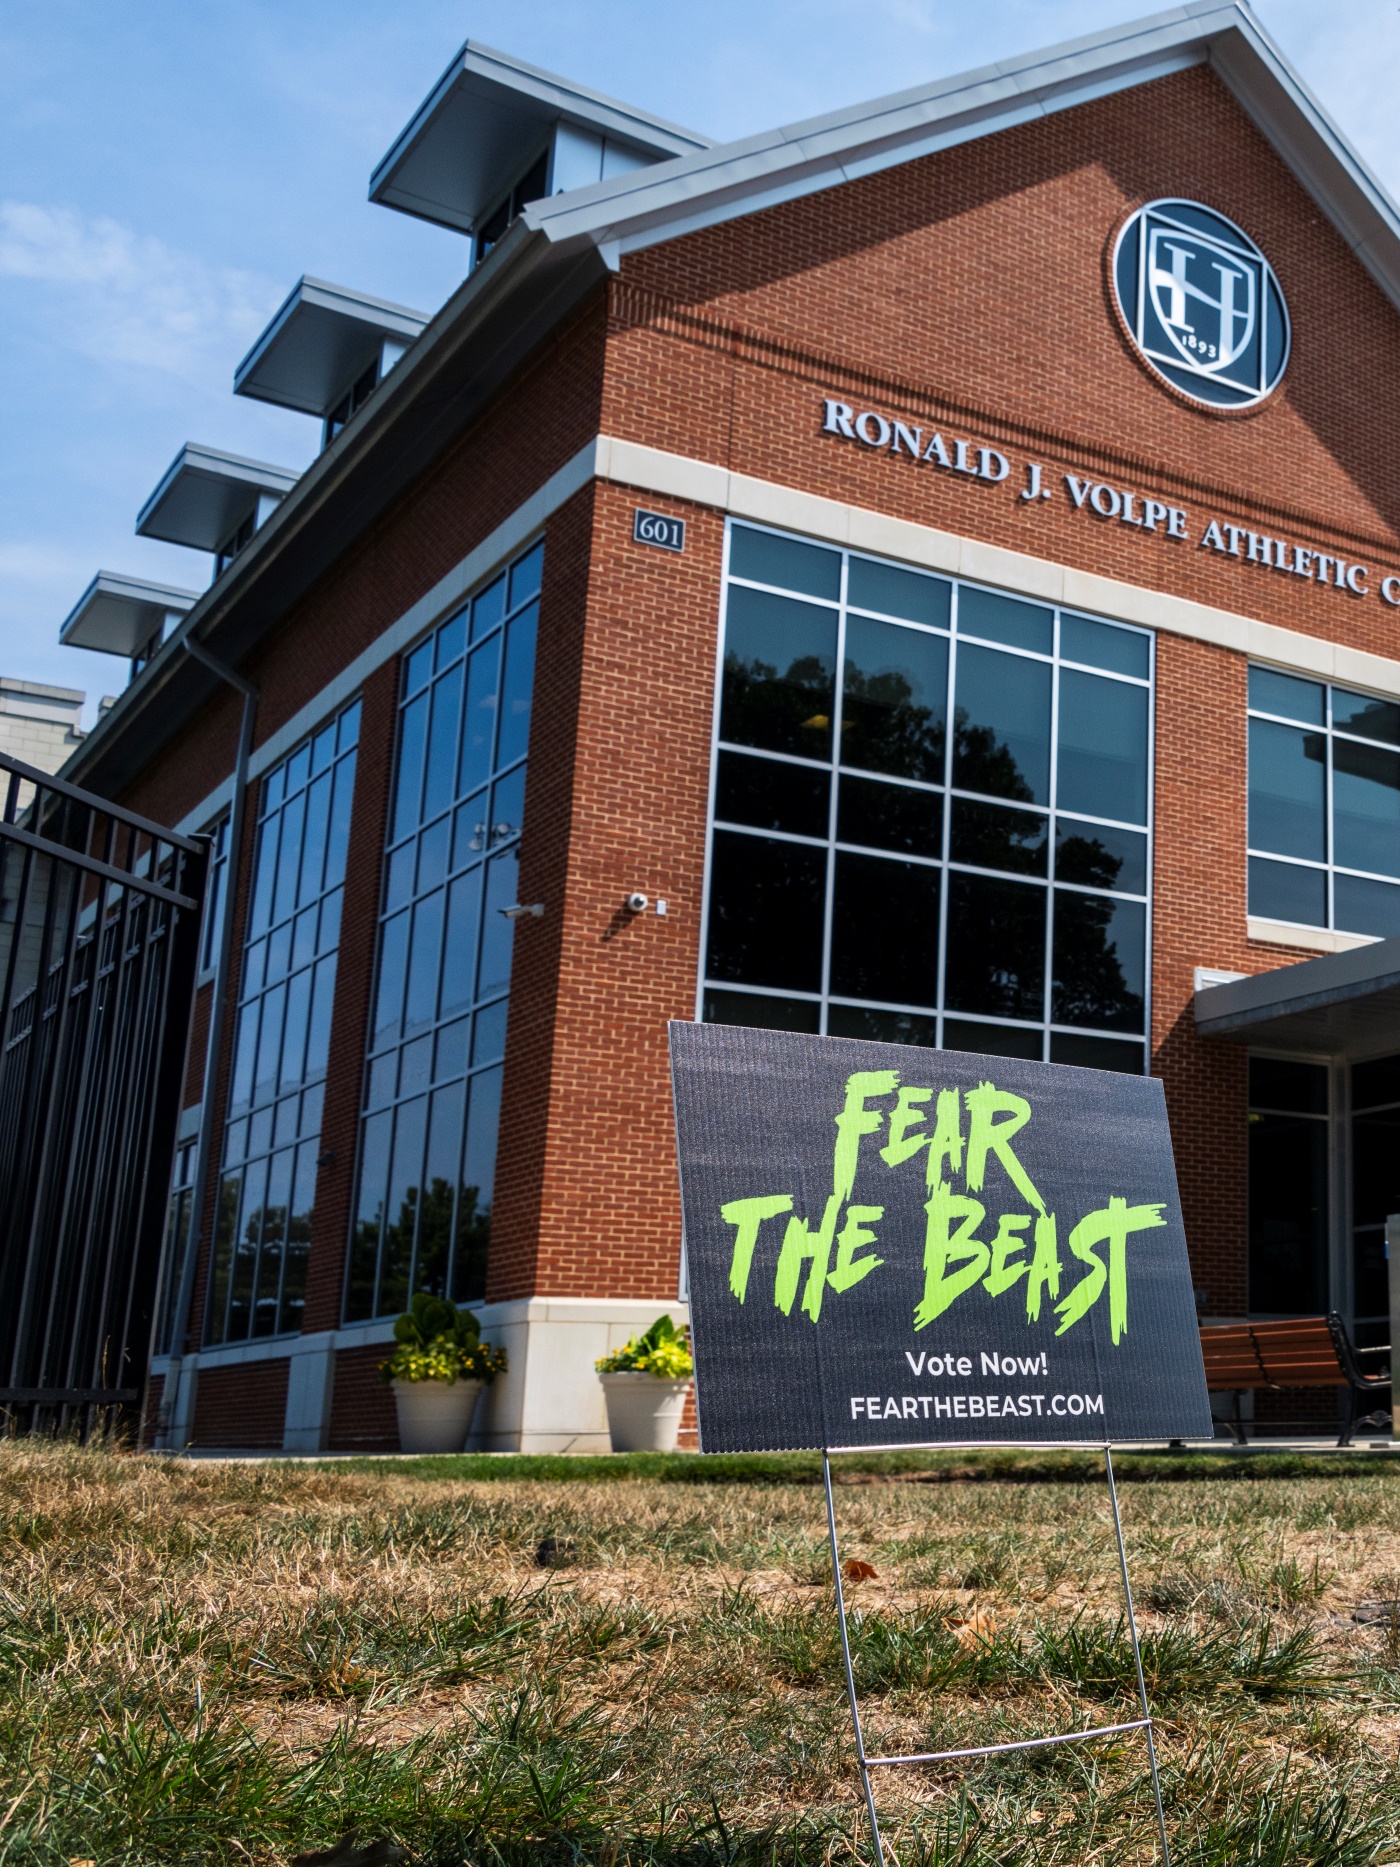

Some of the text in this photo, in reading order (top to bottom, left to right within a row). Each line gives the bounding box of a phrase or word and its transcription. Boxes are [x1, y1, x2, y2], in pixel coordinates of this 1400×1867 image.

[1181, 334, 1217, 358] 1893
[823, 400, 1010, 482] RONALD
[1021, 463, 1052, 500] J.
[1065, 474, 1188, 539] VOLPE
[1201, 520, 1369, 595] ATHLETIC
[640, 516, 679, 546] 601
[834, 1070, 1046, 1214] FEAR
[721, 1181, 1167, 1346] THE BEAST
[905, 1351, 1048, 1376] Vote Now!
[850, 1394, 1104, 1419] FEARTHEBEAST.COM
